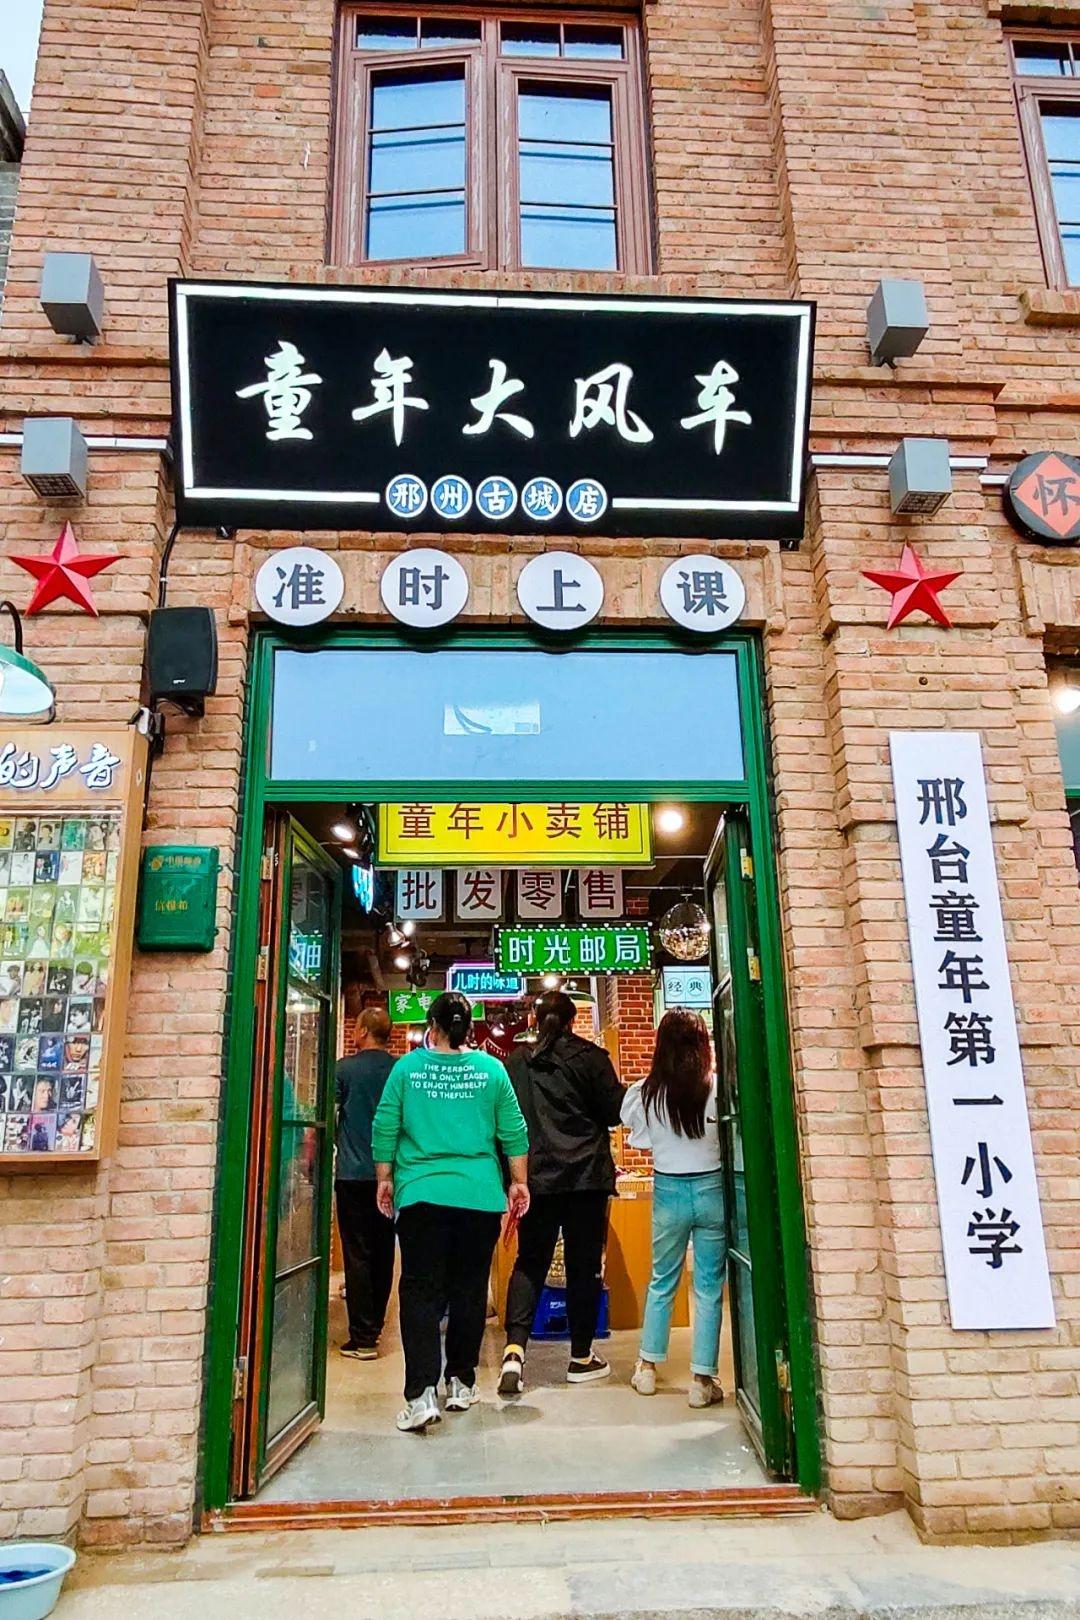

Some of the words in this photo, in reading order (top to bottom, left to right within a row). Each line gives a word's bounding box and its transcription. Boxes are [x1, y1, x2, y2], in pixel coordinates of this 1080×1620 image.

[236, 340, 753, 455] 童年大风车
[390, 482, 600, 516] 邢州古城店
[272, 563, 730, 616] 准时上课
[397, 803, 631, 840] 童年小卖铺
[402, 870, 616, 911] 批发零售
[508, 934, 641, 966] 时光邮局
[667, 981, 703, 993] 经典
[917, 777, 1023, 1269] 邢台童年第一小学
[409, 1072, 427, 1080] WHO
[429, 1073, 437, 1081] IS
[439, 1073, 461, 1082] ONLY
[463, 1072, 489, 1081] EAGER
[424, 1063, 440, 1072] THE
[441, 1064, 476, 1073] PERSON
[411, 1081, 421, 1089] TO
[427, 1090, 438, 1098] TO
